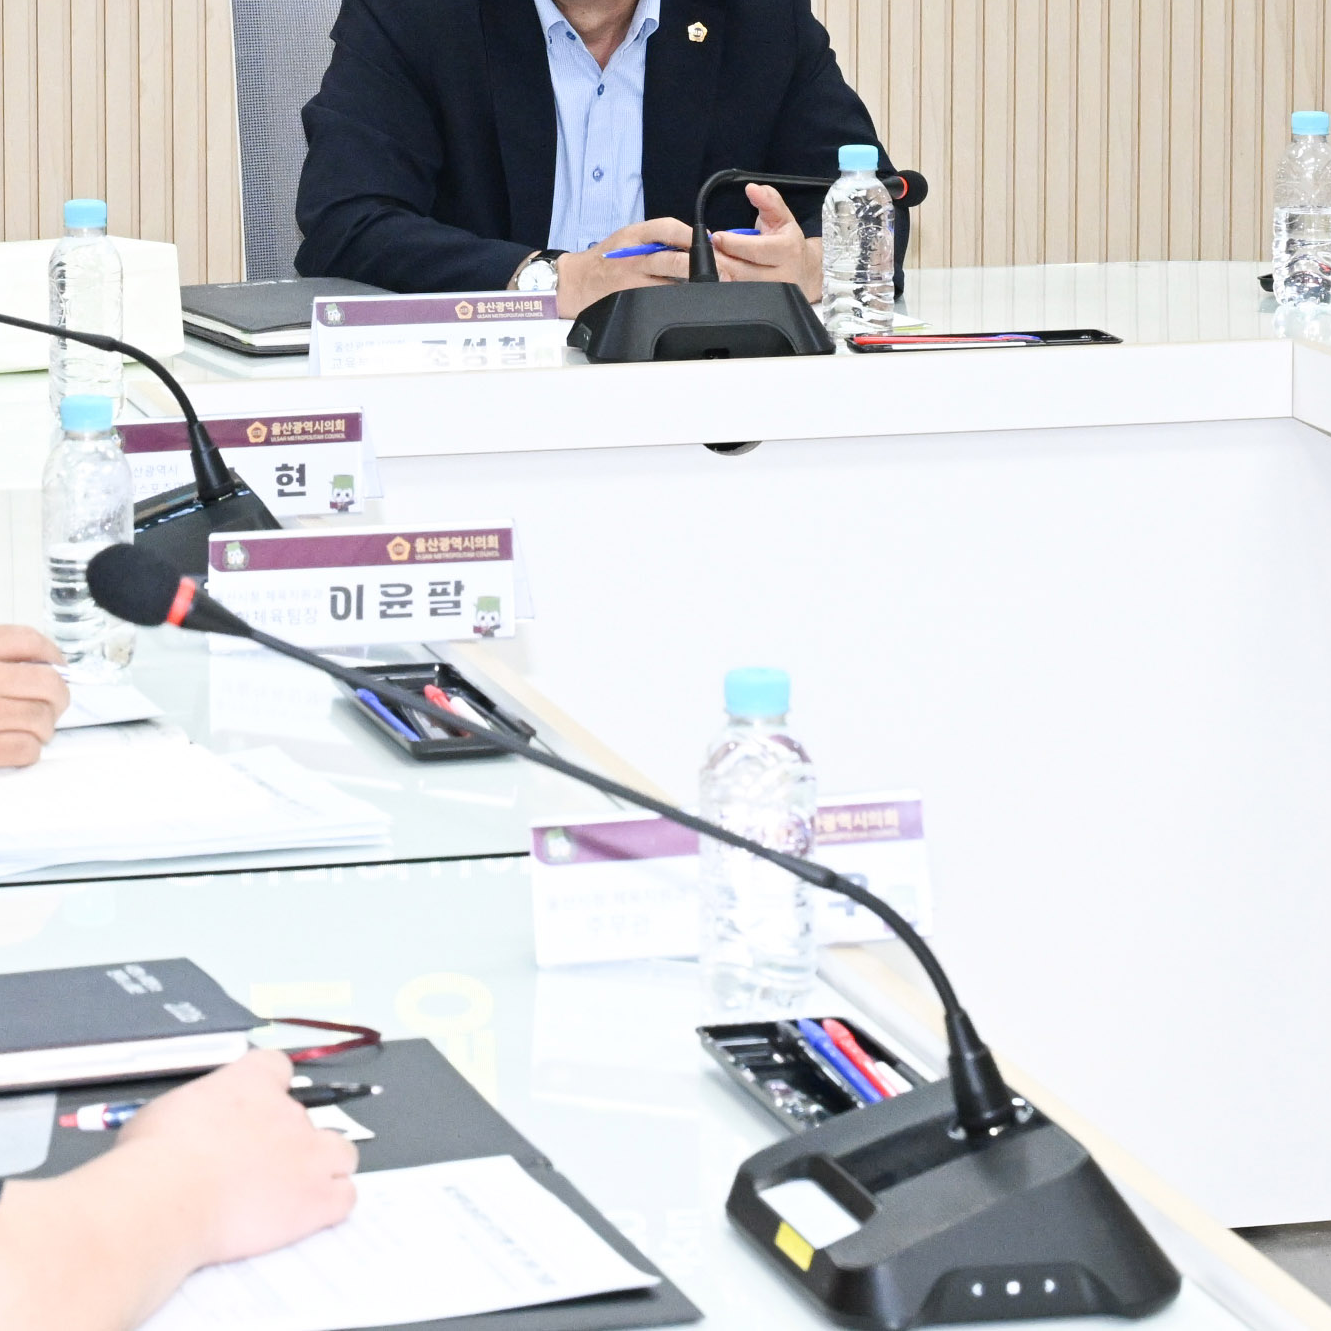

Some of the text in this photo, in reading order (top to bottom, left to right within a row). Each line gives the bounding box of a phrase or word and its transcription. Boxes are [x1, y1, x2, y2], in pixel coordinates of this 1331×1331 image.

[476, 300, 543, 314] 울산광역시의회
[271, 419, 345, 436] 울산광역시의회
[414, 534, 499, 553] 울산광역시의회
[329, 580, 465, 621] 이윤팔
